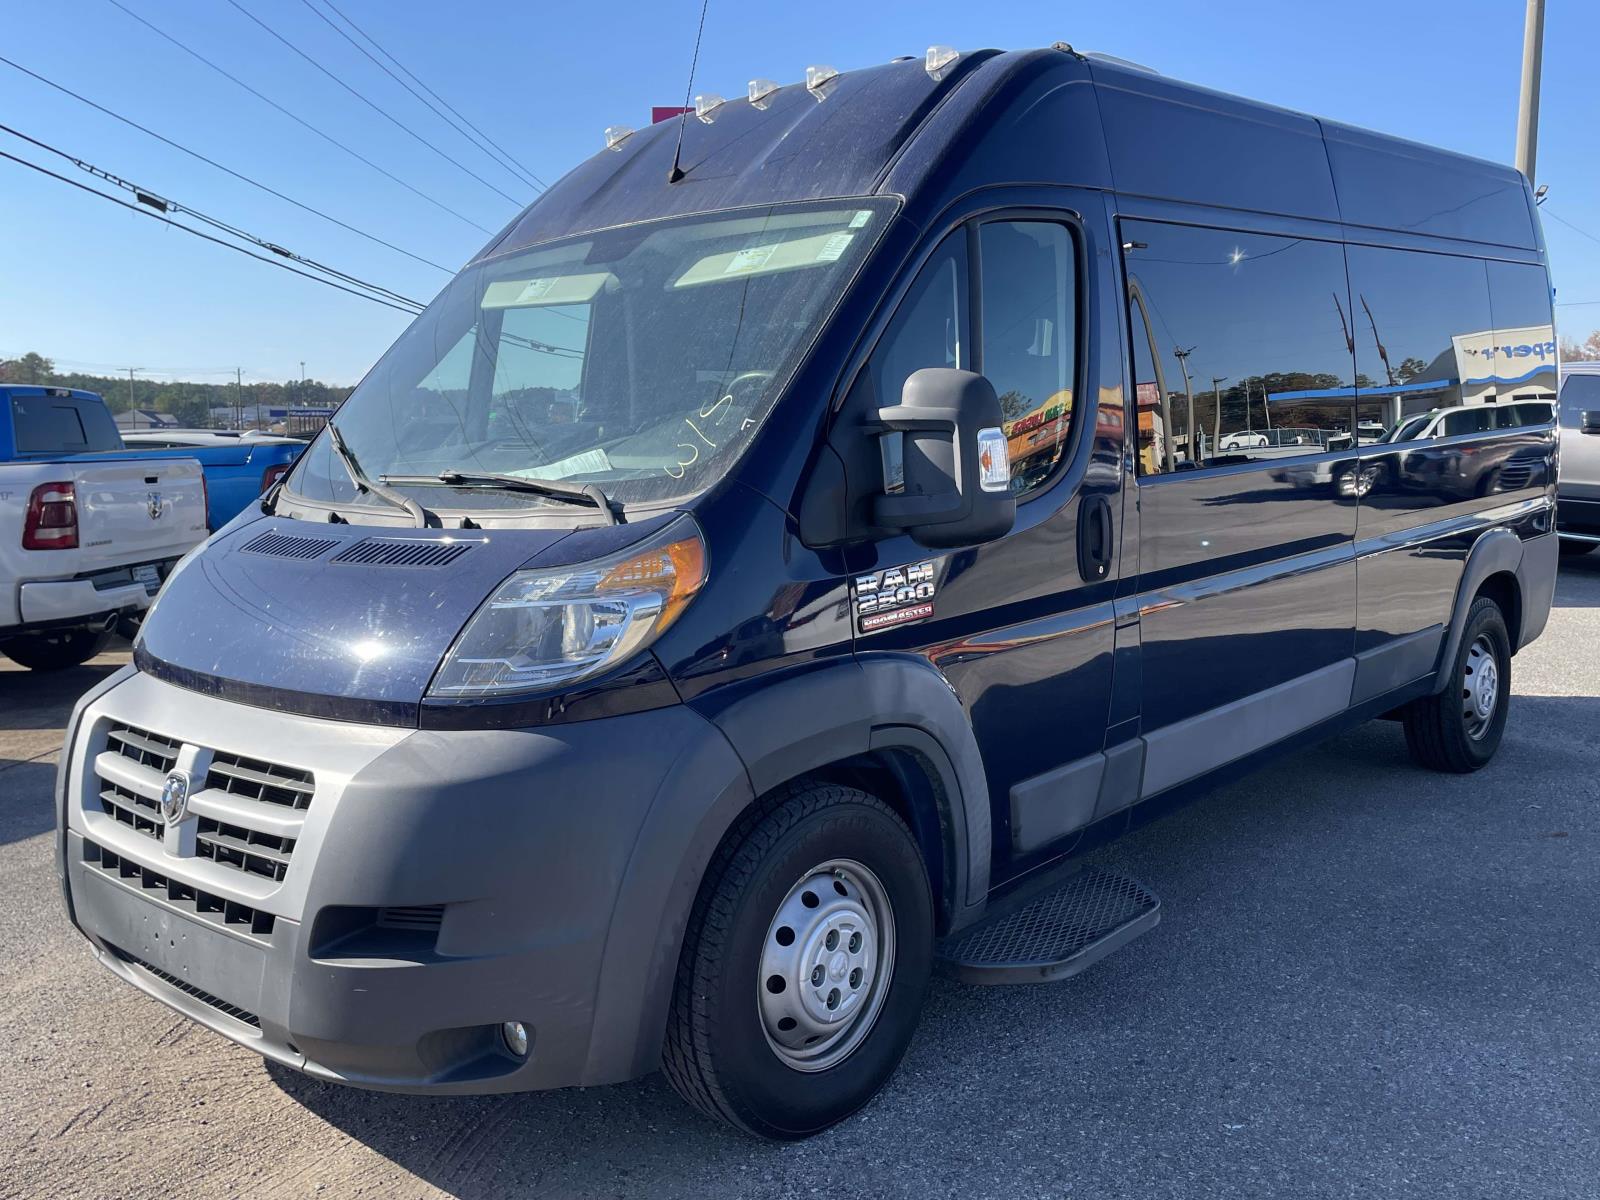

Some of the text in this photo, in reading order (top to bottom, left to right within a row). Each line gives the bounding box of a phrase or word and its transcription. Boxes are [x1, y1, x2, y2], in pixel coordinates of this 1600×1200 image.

[856, 563, 933, 594] RAM
[857, 582, 935, 613] 2500
[863, 606, 932, 627] PROMASTER
